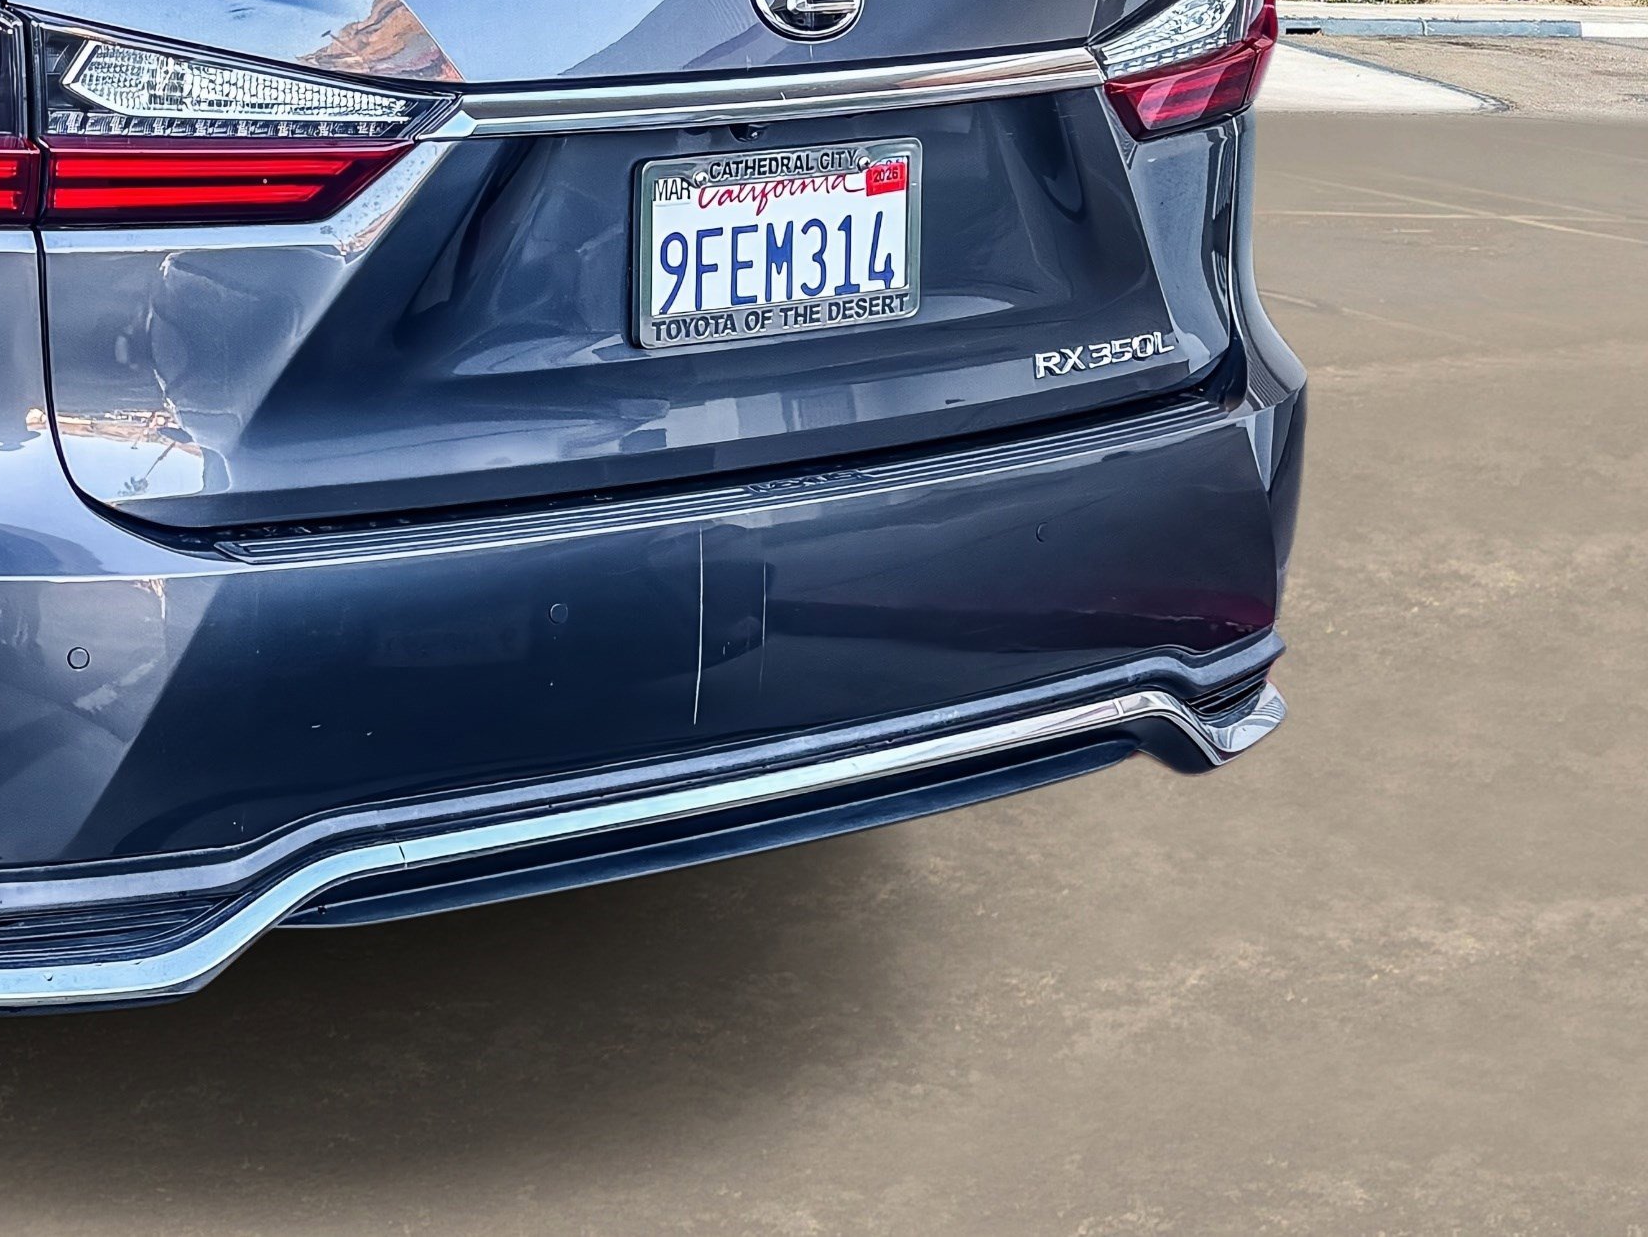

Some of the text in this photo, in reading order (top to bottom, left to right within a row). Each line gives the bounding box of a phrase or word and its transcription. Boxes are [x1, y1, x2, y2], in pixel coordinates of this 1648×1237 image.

[709, 148, 858, 181] CATHEDRAL CITY
[873, 166, 899, 183] 2026
[653, 178, 691, 201] MAR
[659, 211, 895, 315] 9FEM314
[652, 293, 910, 342] TOYOTA OF THE DESERT
